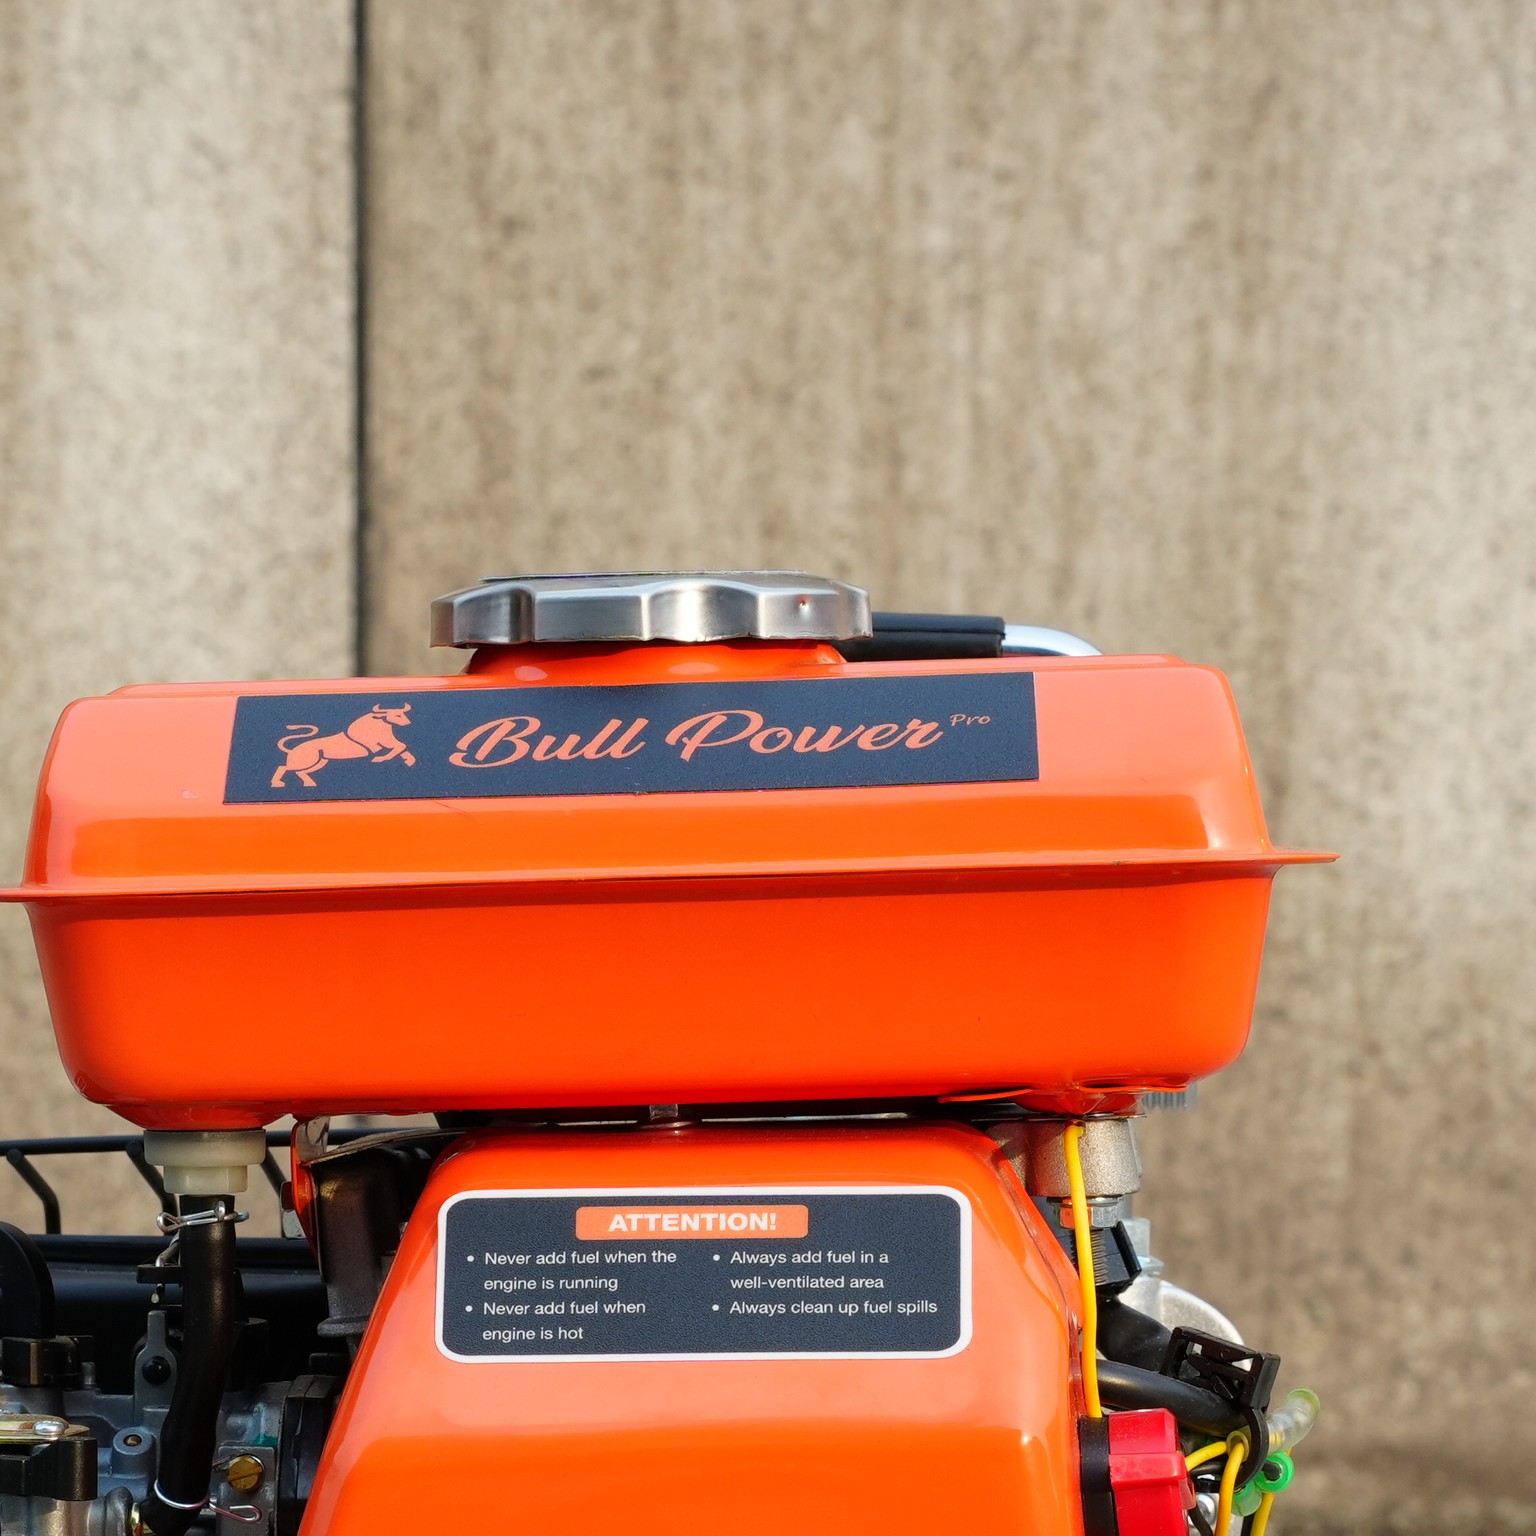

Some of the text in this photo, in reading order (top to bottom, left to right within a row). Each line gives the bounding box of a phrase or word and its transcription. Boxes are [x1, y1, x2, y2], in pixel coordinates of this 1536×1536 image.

[449, 709, 991, 768] Bull Power Pro
[610, 1213, 776, 1231] ATTENTION!
[485, 1251, 677, 1265] Never add fuel when the
[730, 1250, 889, 1266] Always add fuel in a
[484, 1276, 618, 1293] engine is running
[730, 1275, 885, 1289] well-ventilated area
[483, 1301, 646, 1315] Never add fuel when
[729, 1300, 938, 1316] Always clean up fuel spills
[482, 1326, 584, 1343] engine is hot
